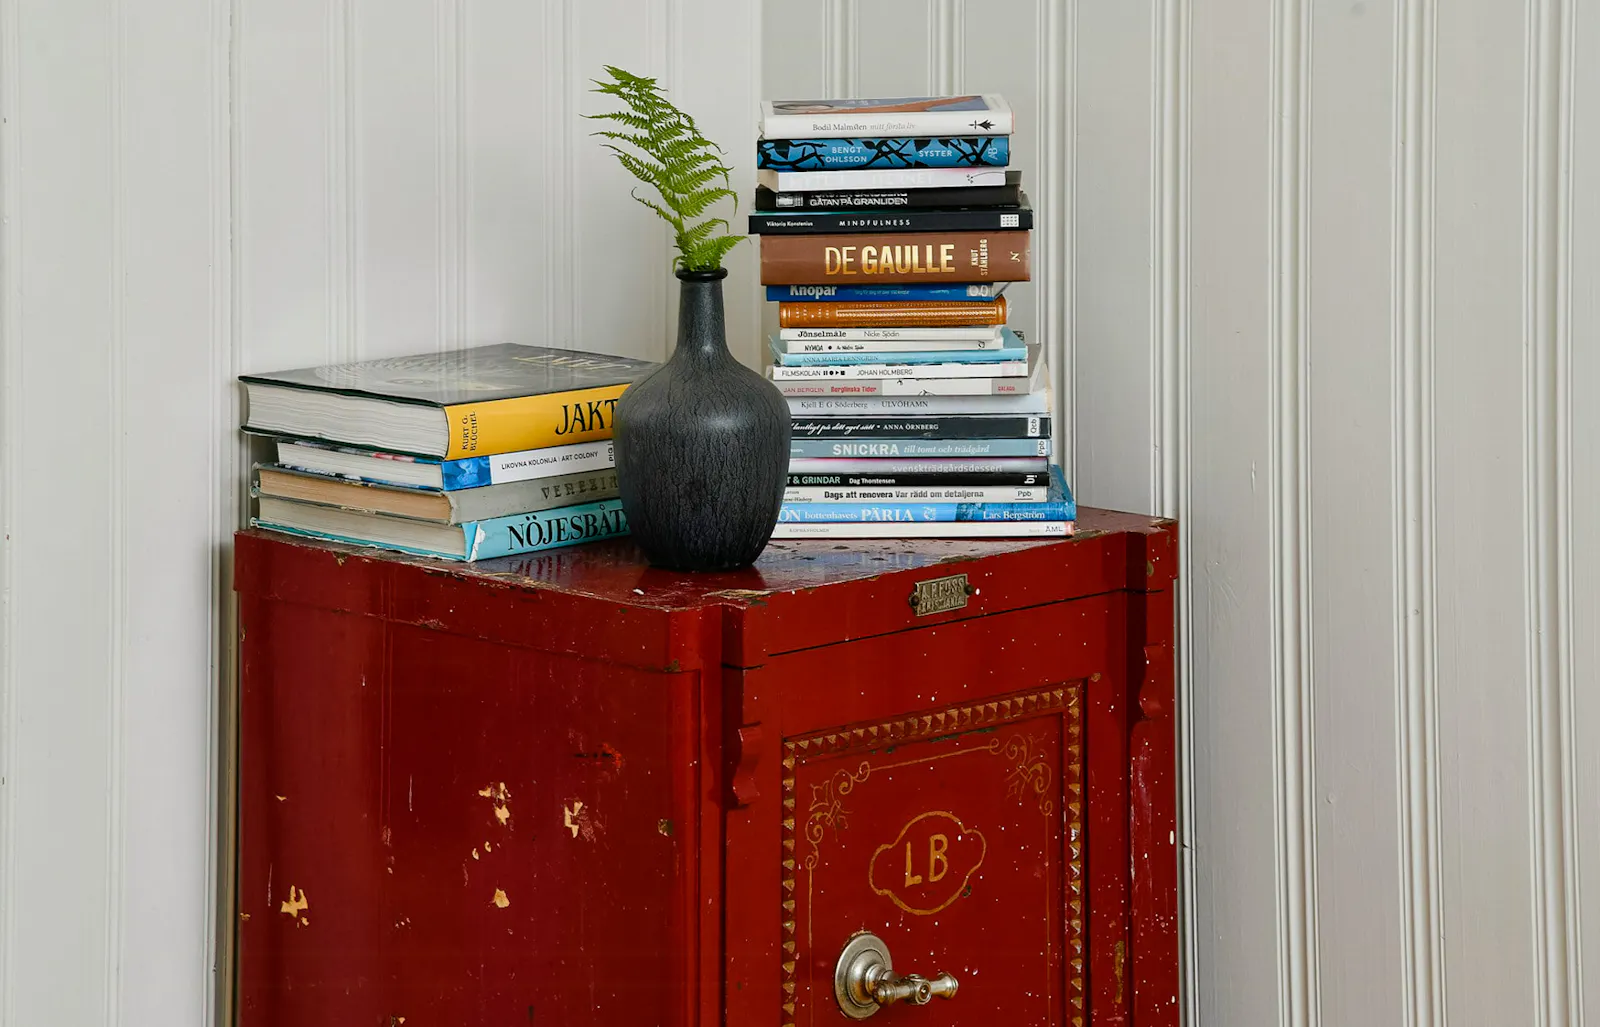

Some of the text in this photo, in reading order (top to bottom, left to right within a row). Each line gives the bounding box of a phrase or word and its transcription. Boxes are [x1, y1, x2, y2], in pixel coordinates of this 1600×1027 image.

[812, 123, 832, 132] Bodil
[833, 123, 868, 131] Malmsten
[831, 146, 863, 154] BENGT
[825, 155, 868, 163] OHLSSON
[809, 197, 908, 207] GÅTAN PÅ GRANLIDEN
[839, 219, 911, 227] MINDFULNESS
[825, 244, 956, 275] DE GAULLE
[970, 249, 979, 267] KNUT
[979, 239, 988, 276] STÅHLBERG
[789, 285, 837, 299] Knopar
[881, 330, 900, 338] Sjödin
[831, 386, 861, 394] Berglinska
[801, 401, 817, 409] Kjell
[834, 401, 868, 409] Söderberg
[881, 400, 928, 408] ULVÖHAMN
[905, 422, 939, 431] ÖRNBERG
[461, 427, 470, 450] KURT
[832, 444, 990, 456] SNICKRA till tomt och trädgård
[501, 451, 599, 470] LIKOVNA KOLONIJA ART COLONY
[802, 476, 841, 484] GRINDAR
[824, 491, 844, 500] Dags
[910, 490, 928, 498] rädd
[944, 490, 984, 500] detaljerna
[1017, 490, 1032, 498] Ppb
[804, 510, 858, 519] bottenhavets
[983, 510, 1001, 519] Lars
[1003, 509, 1045, 520] Bergström
